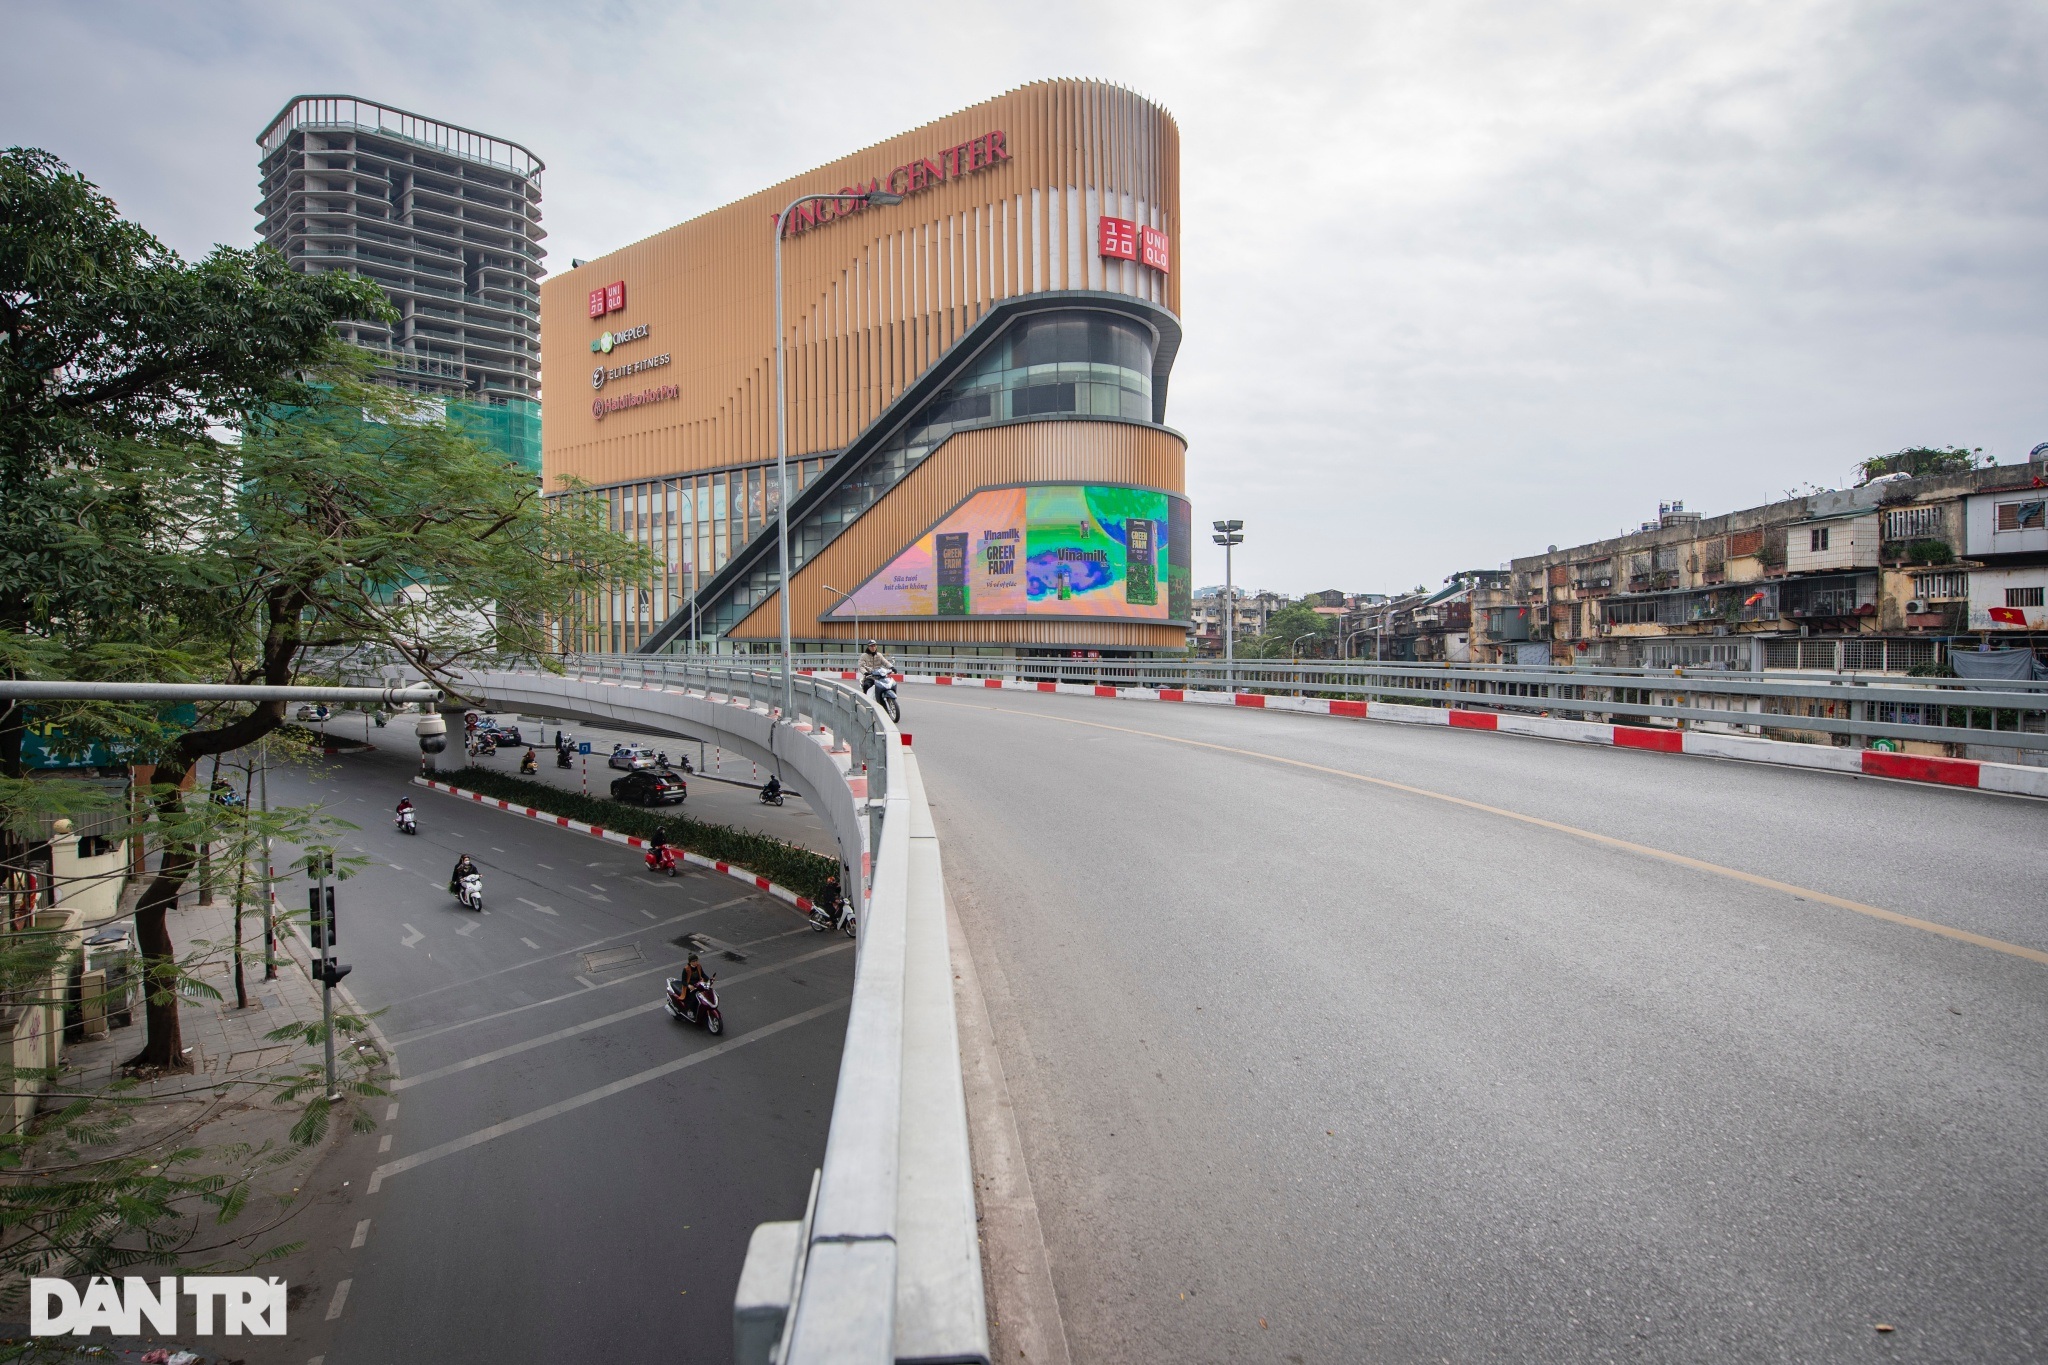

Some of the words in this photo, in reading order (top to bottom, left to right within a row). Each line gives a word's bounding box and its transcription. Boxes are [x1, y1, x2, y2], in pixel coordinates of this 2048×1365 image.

[885, 130, 1013, 197] CENTER
[1147, 230, 1165, 251] UNI
[1147, 247, 1167, 267] QLO
[608, 284, 620, 297] UNI
[608, 295, 621, 309] QLO
[613, 323, 649, 345] CINEPLEX
[609, 363, 632, 380] ELITE
[634, 352, 671, 373] FITNESS
[983, 528, 1020, 540] Vinamilk
[987, 545, 1015, 560] GREEN
[1057, 548, 1108, 562] Vinamilk
[988, 560, 1014, 575] FARM
